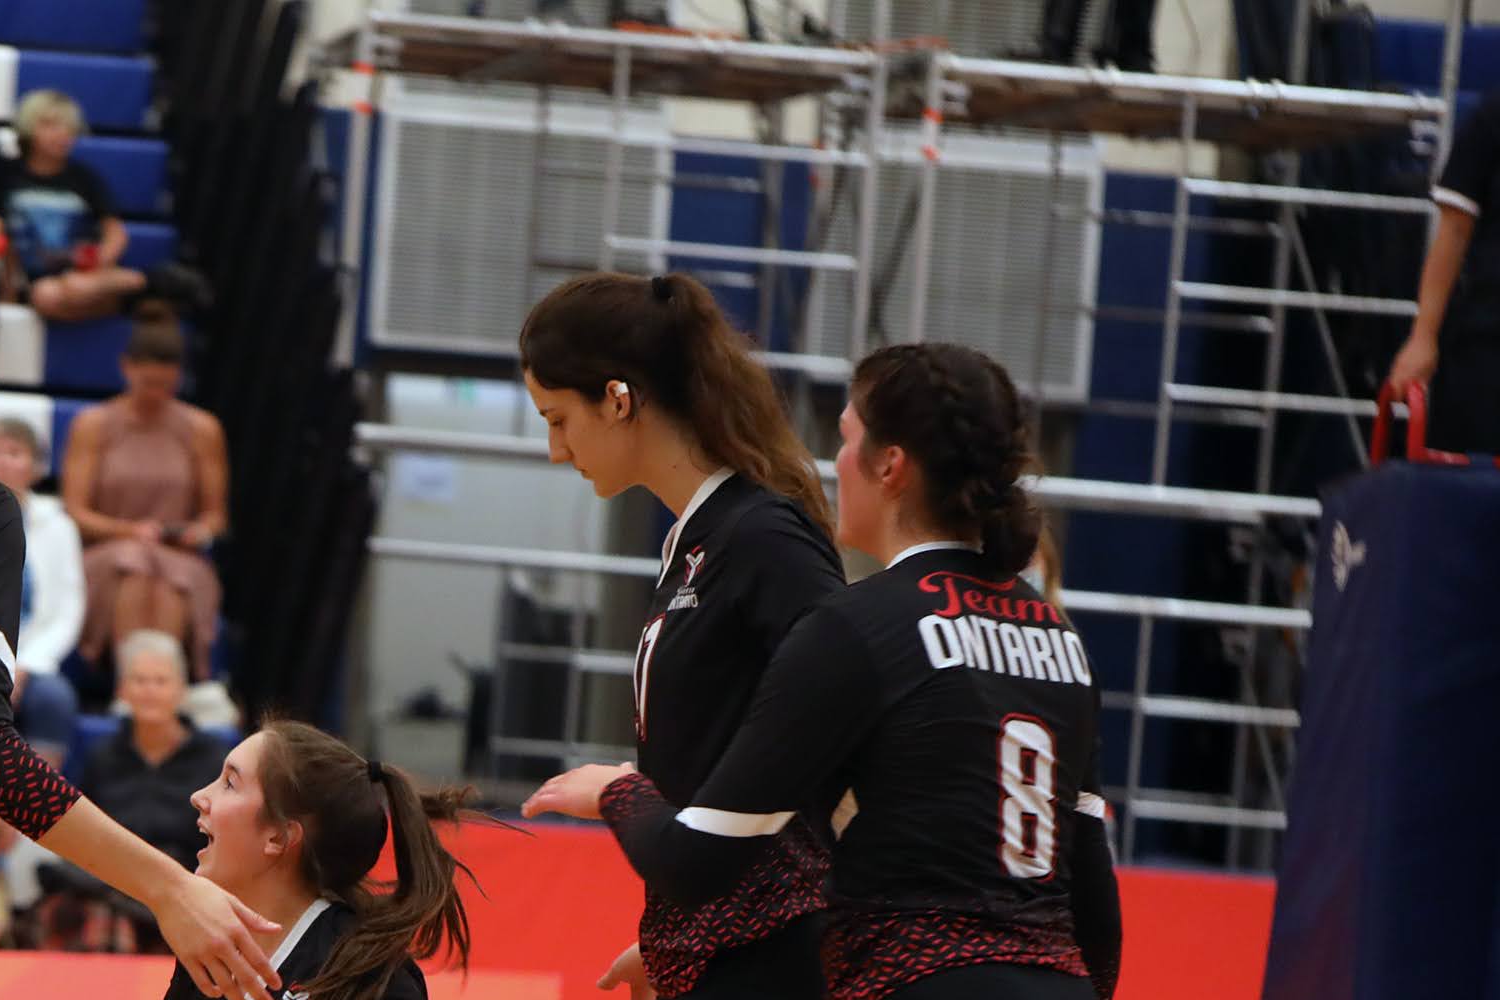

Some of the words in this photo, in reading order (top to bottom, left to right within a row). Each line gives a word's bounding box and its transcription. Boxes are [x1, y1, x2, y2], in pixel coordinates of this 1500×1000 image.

[918, 571, 1061, 624] Team
[918, 614, 1092, 687] ONTARIO
[997, 712, 1059, 882] 8
